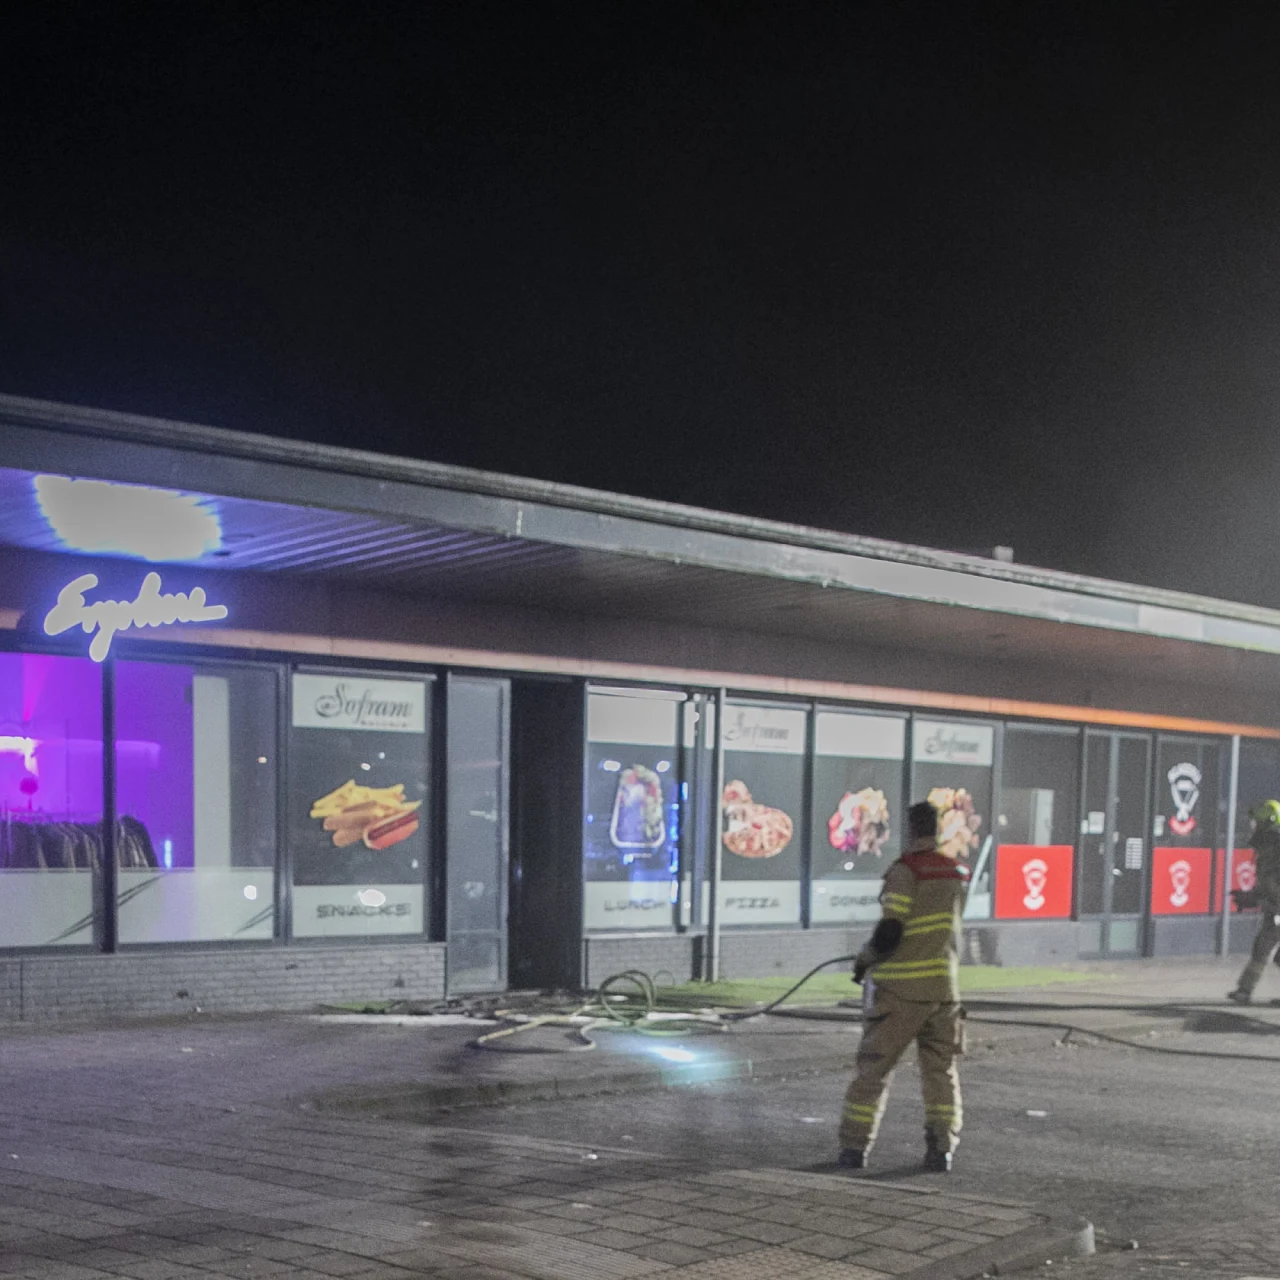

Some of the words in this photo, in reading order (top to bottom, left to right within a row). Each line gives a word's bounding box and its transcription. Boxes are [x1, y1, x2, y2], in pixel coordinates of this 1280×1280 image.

[603, 899, 666, 911] LUNCH
[724, 897, 780, 909] PIZZA
[316, 903, 411, 918] SNACKS
